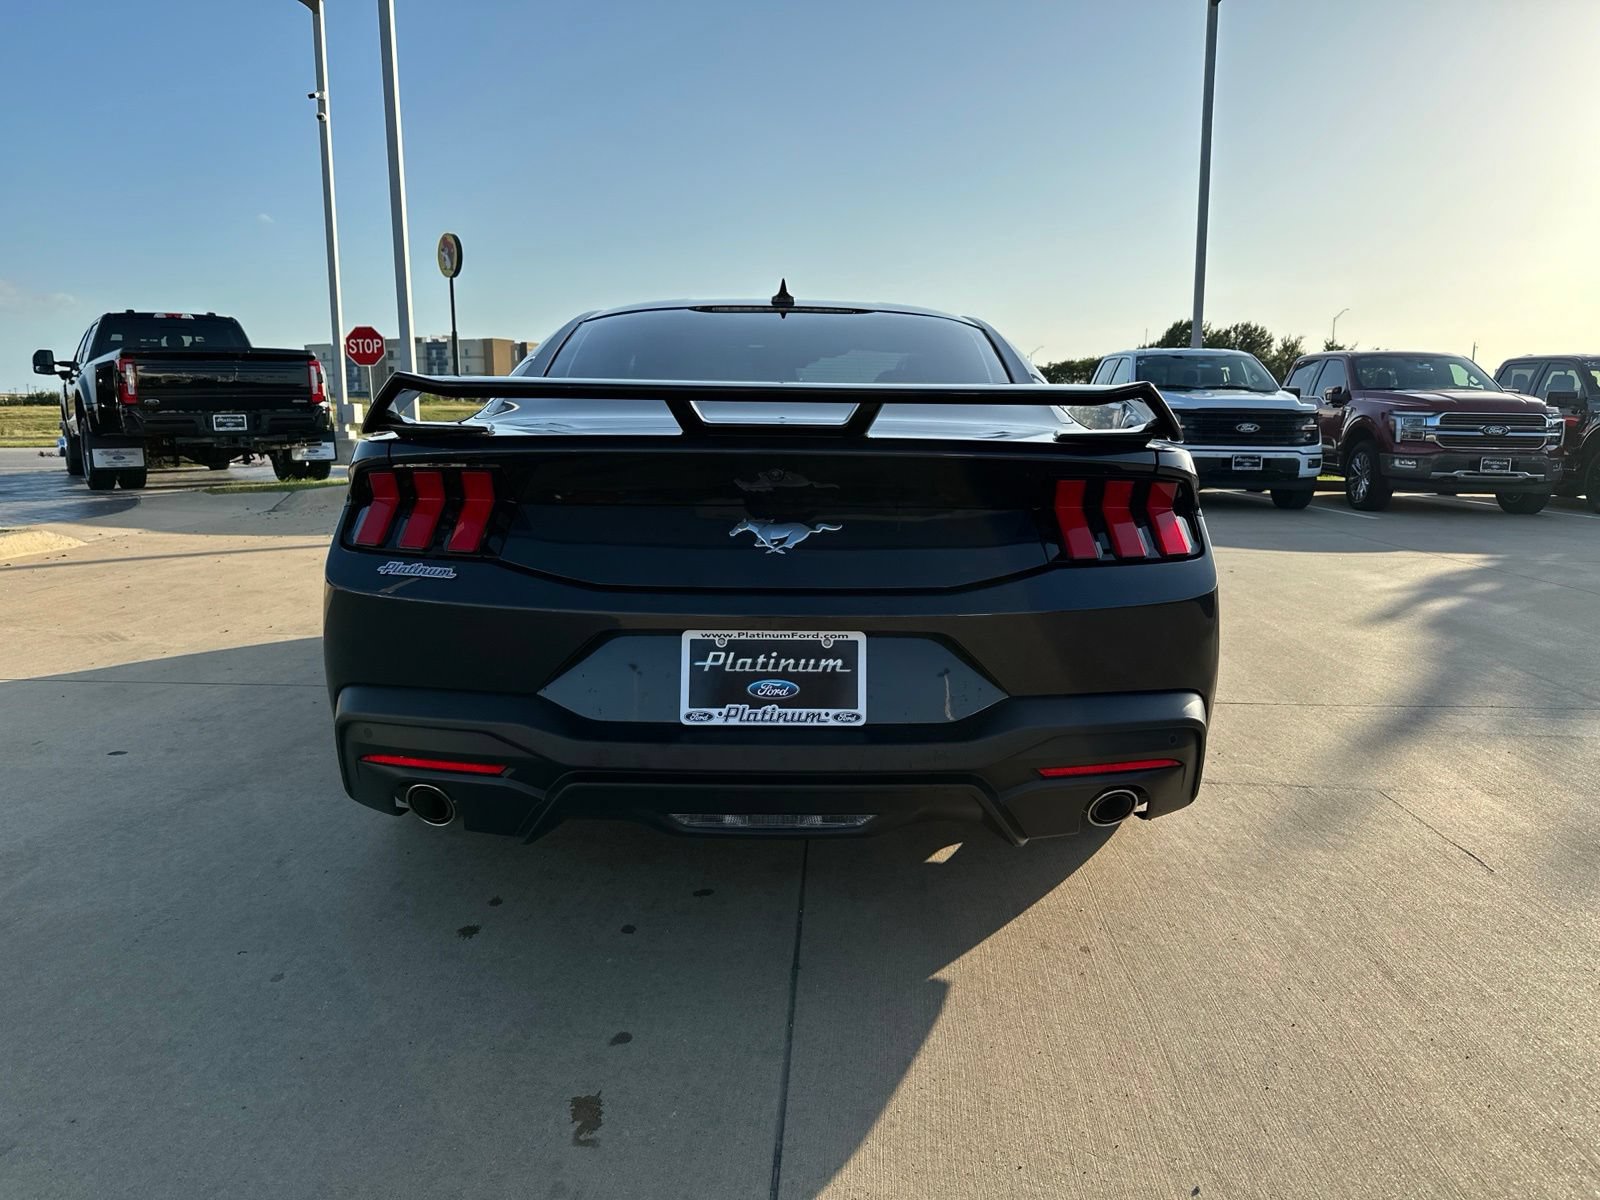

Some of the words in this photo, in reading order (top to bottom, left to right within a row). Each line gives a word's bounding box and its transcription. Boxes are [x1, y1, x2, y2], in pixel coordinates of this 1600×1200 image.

[348, 339, 382, 354] STOP
[377, 561, 457, 578] Platinum
[701, 631, 849, 639] www.PlatinumFord.com
[694, 651, 852, 673] Platinum
[722, 704, 830, 724] Platinum
